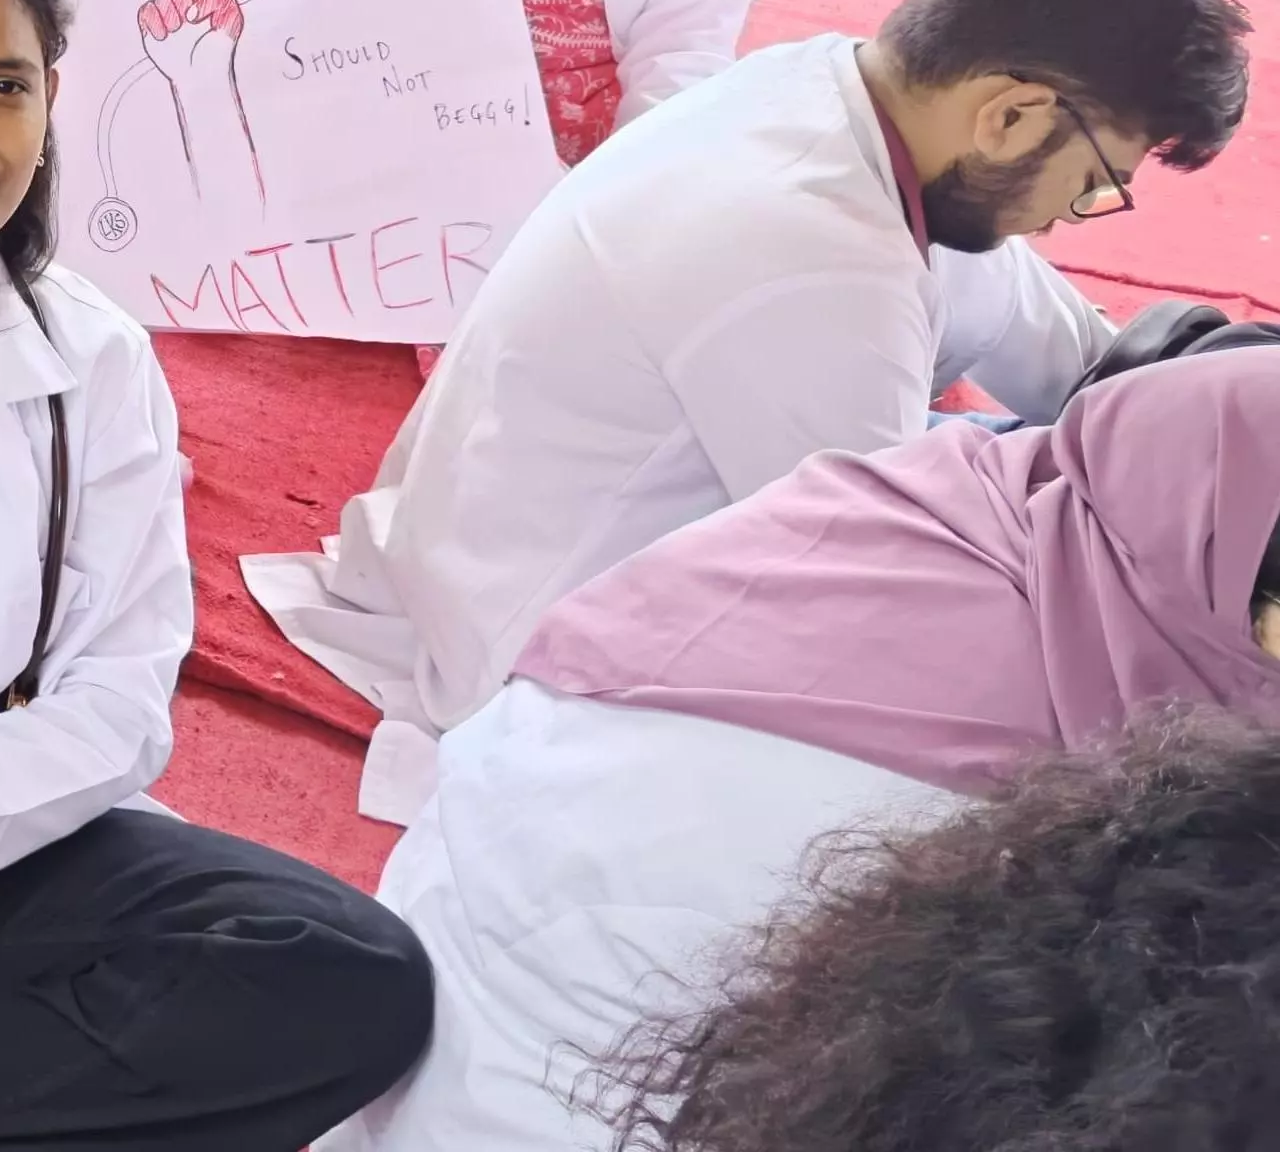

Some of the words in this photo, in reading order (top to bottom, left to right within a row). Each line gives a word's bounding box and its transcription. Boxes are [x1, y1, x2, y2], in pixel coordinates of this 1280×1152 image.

[282, 36, 391, 80] SHOULD
[382, 64, 431, 98] NOT
[150, 216, 493, 334] MATTER
